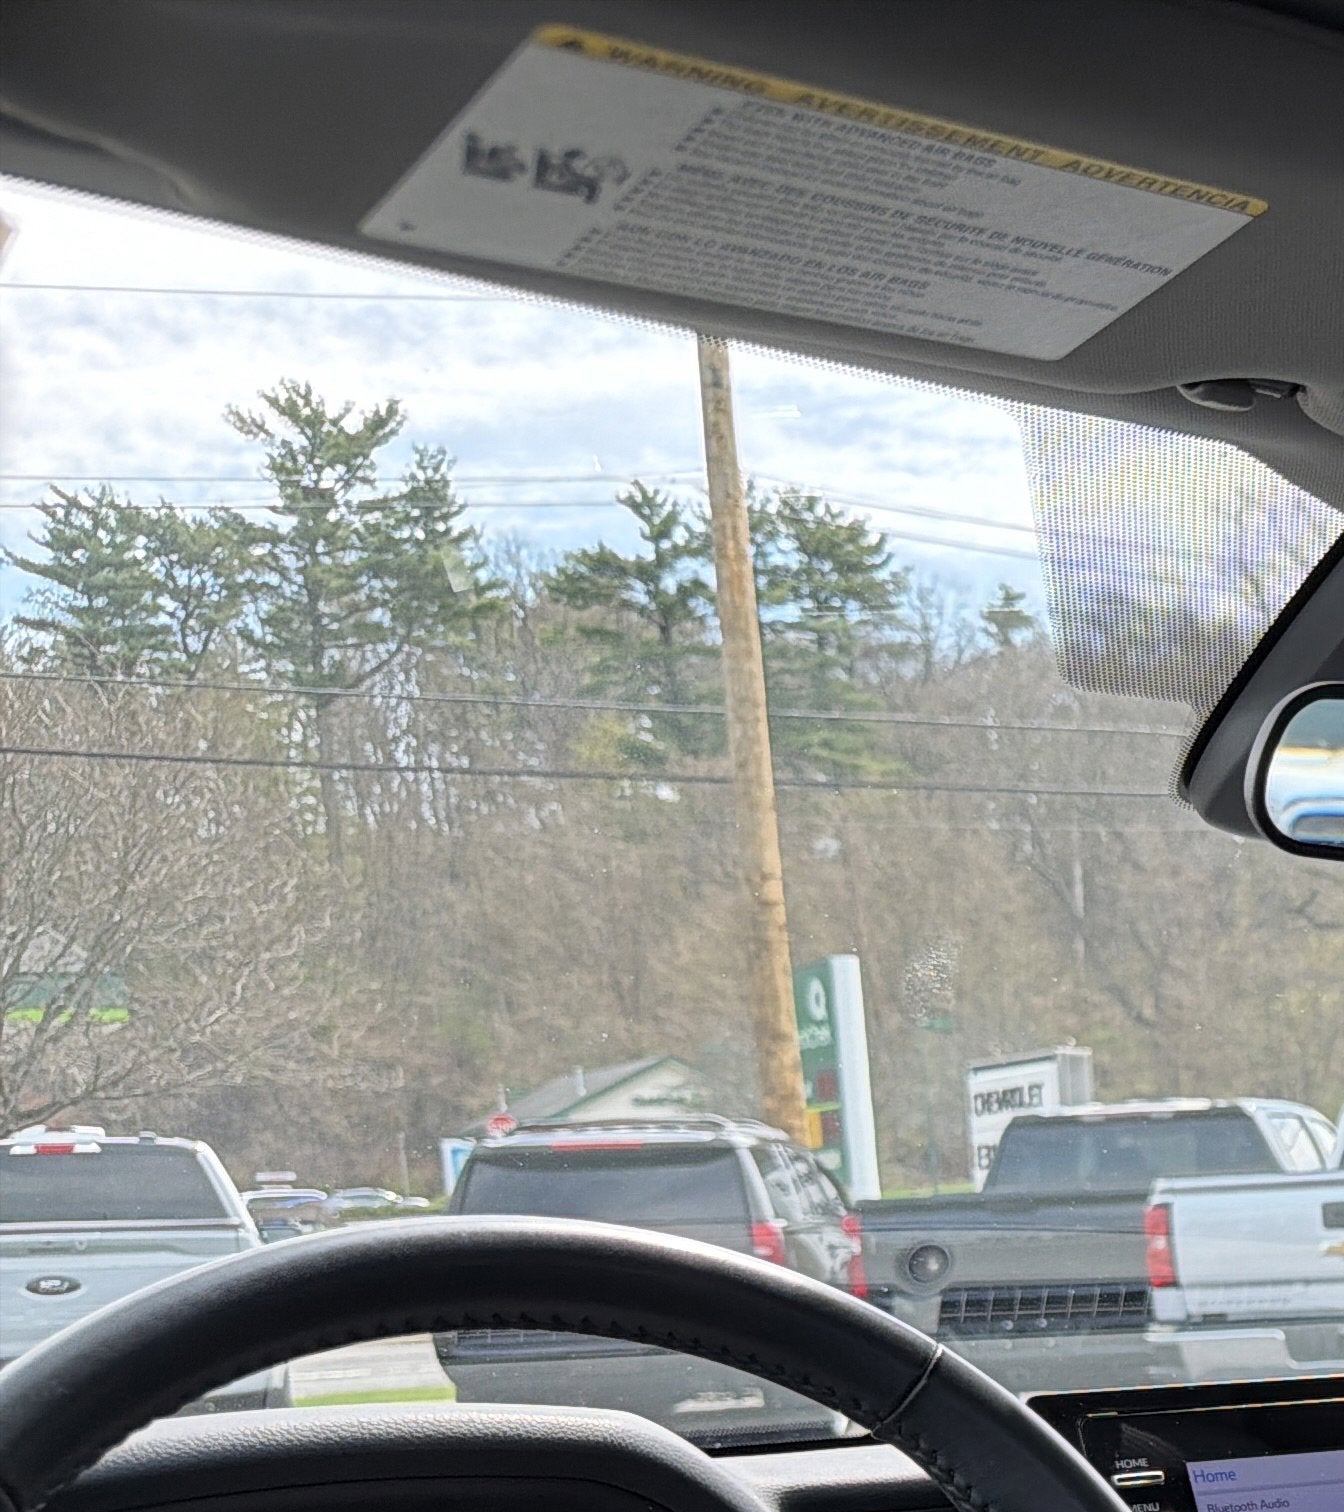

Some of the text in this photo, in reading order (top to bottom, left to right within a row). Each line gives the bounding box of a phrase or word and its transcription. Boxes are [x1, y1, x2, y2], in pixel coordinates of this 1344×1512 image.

[1058, 158, 1250, 212] ADVERTENCIA
[1115, 1458, 1151, 1469] HOME
[1193, 1469, 1238, 1484] Home
[1260, 1497, 1290, 1510] Audio
